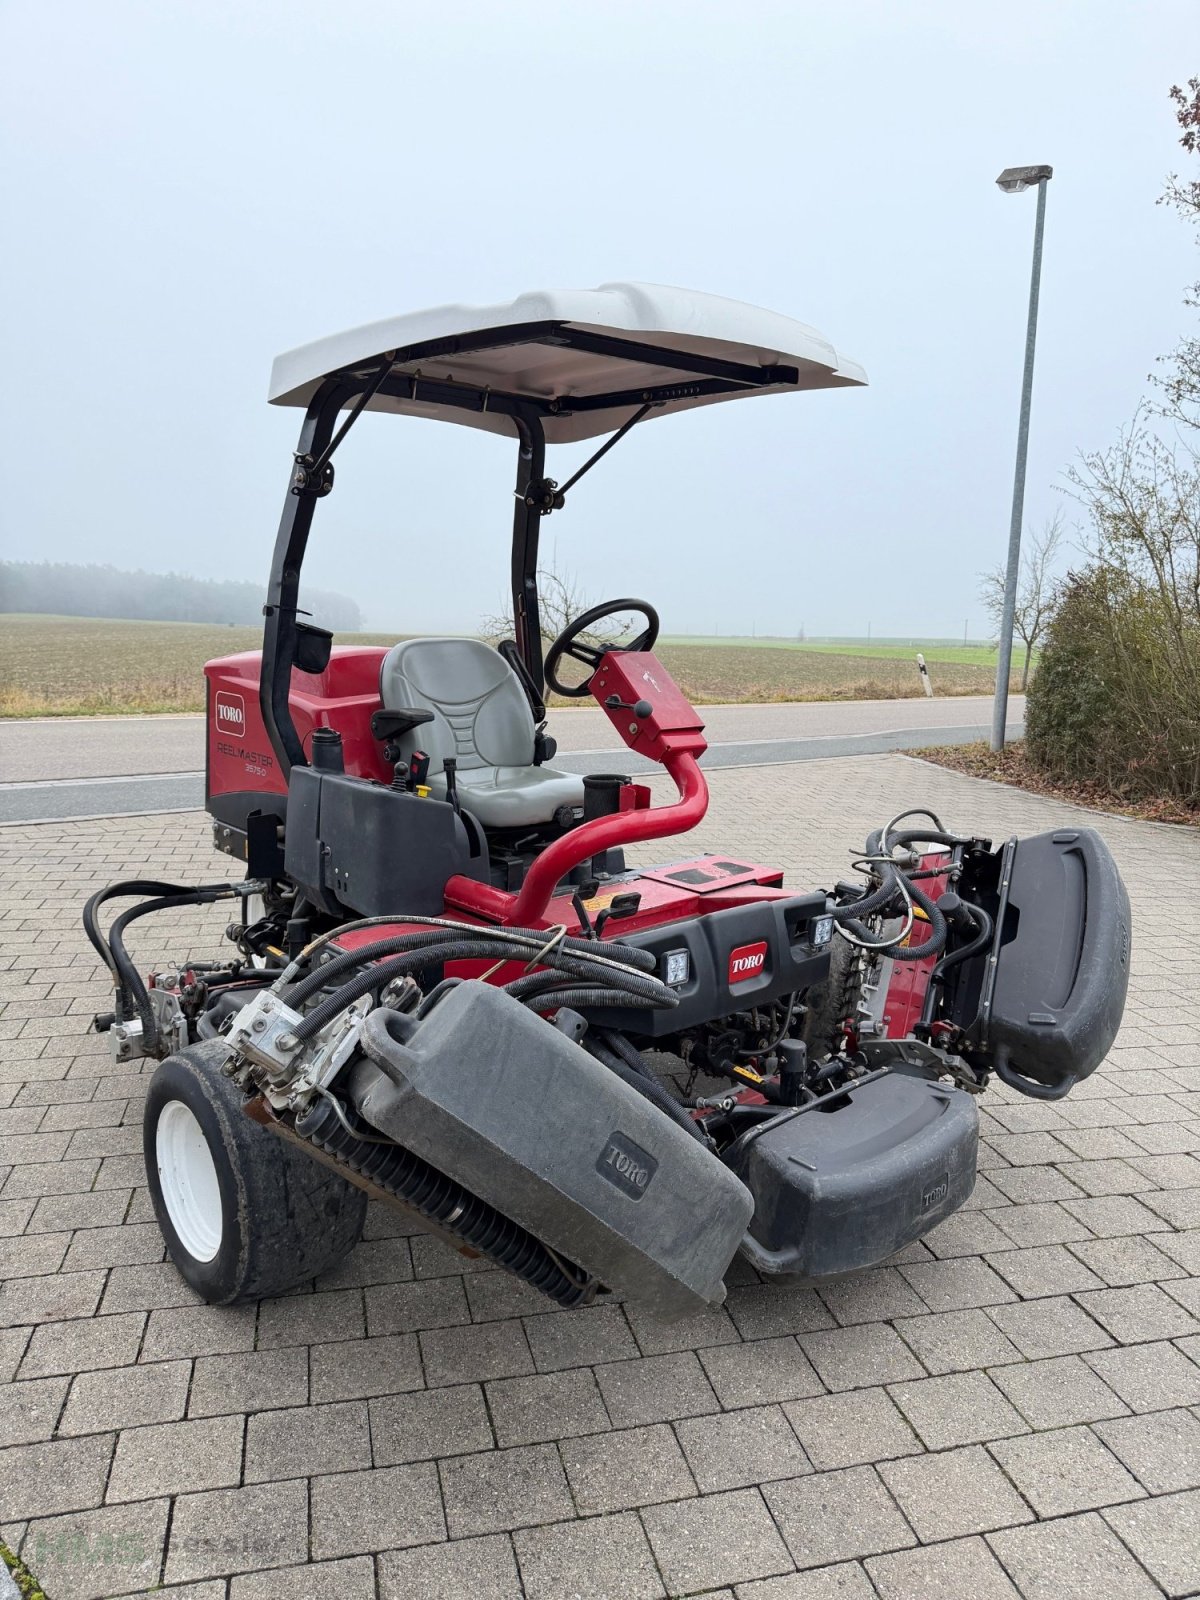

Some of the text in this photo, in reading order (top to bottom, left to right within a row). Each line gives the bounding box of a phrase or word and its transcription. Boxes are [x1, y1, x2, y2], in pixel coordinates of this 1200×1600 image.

[217, 704, 243, 723] TORO
[217, 742, 273, 768] REELMASTER
[732, 953, 765, 974] TORO
[606, 1145, 649, 1188] TORO
[924, 1183, 947, 1207] TORO
